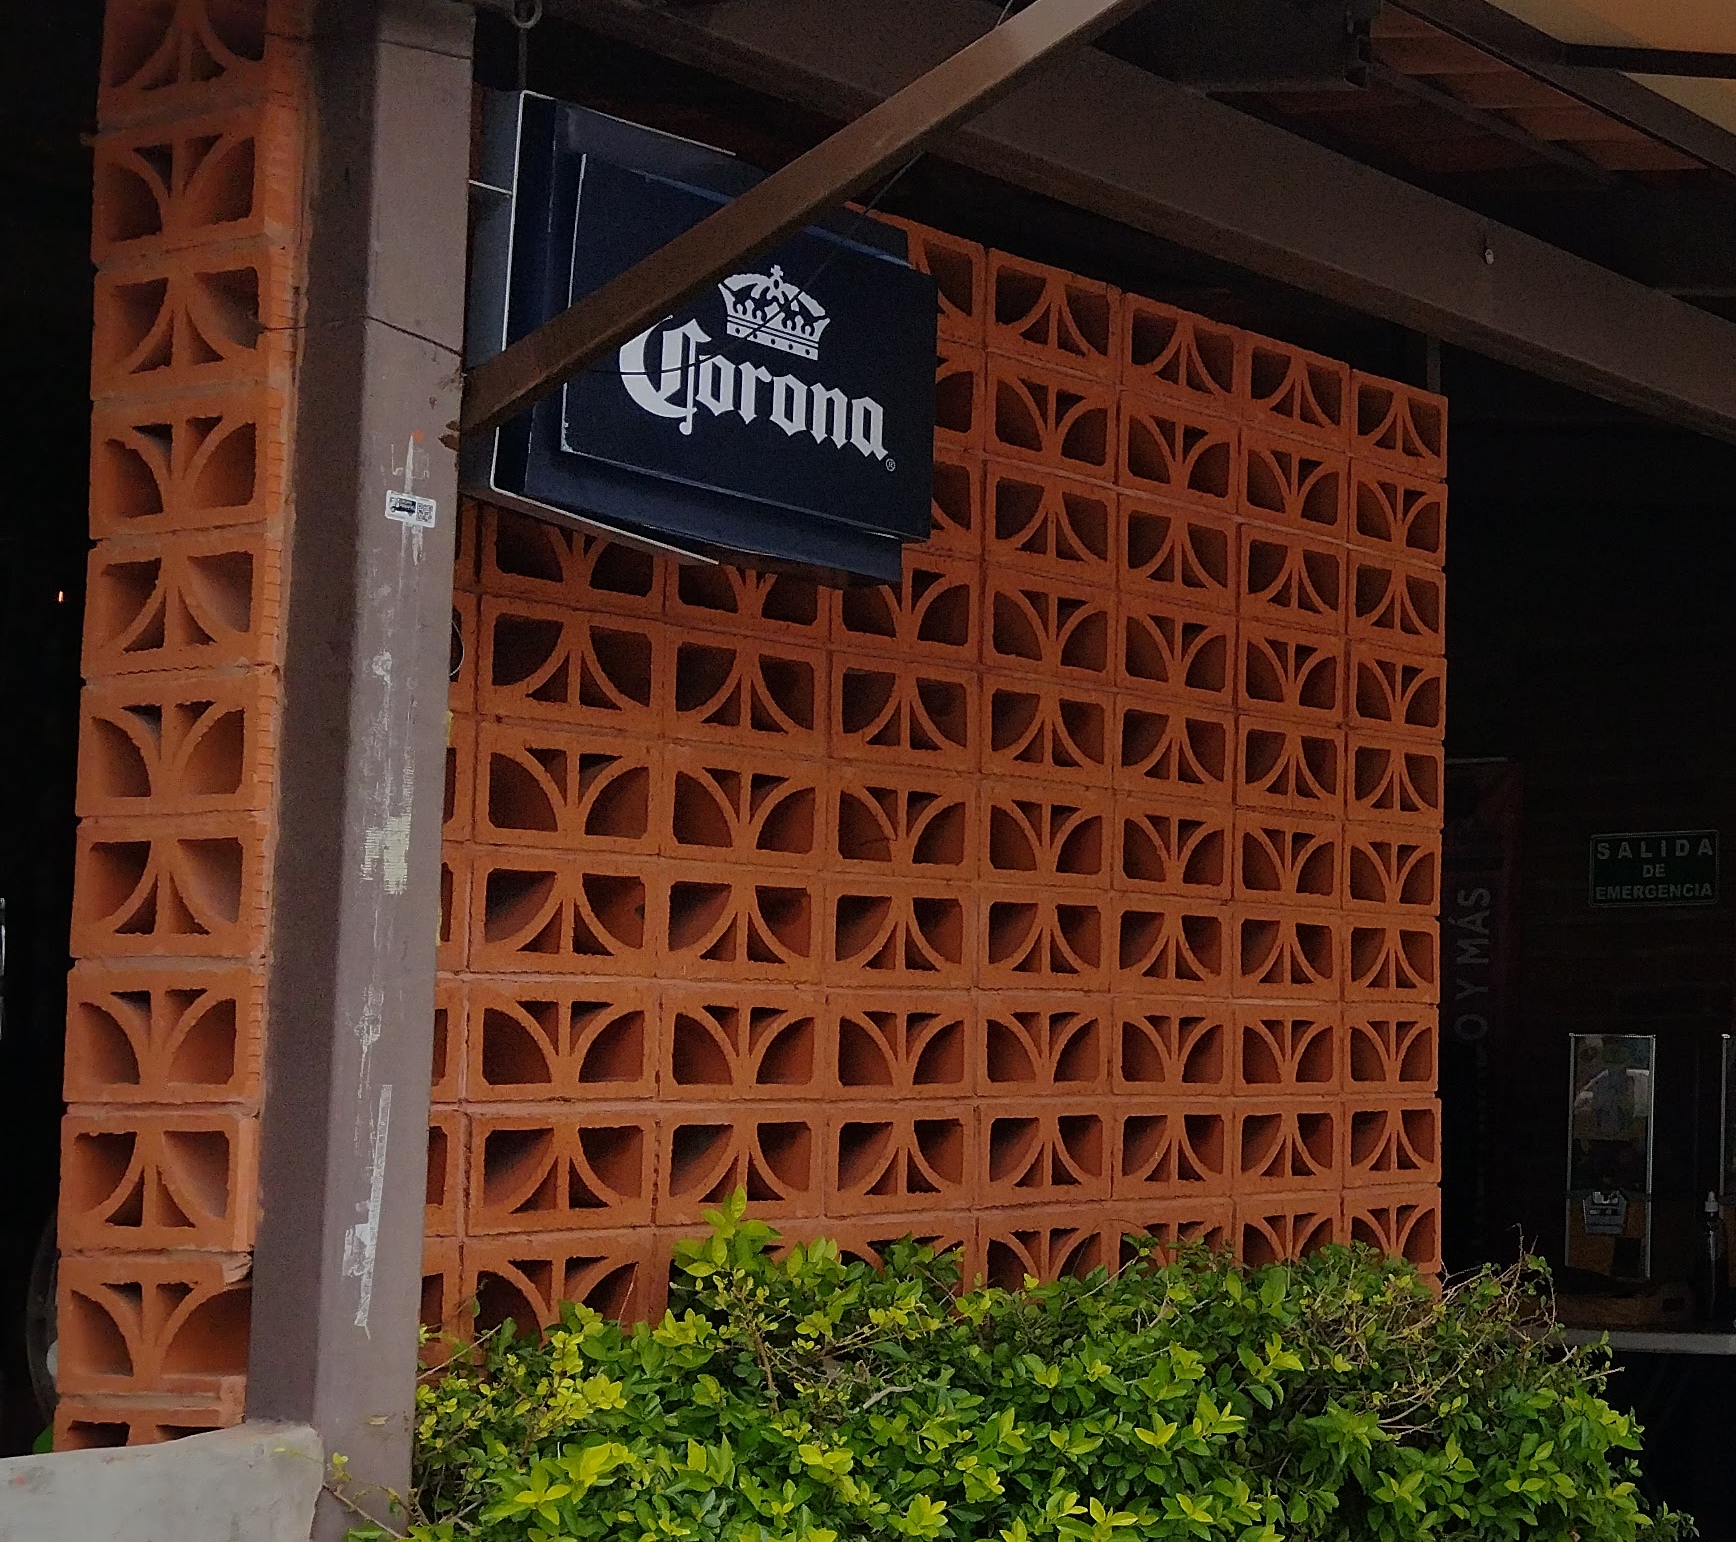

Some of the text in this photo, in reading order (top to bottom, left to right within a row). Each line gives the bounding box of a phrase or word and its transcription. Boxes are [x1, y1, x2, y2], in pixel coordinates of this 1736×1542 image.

[619, 314, 888, 461] Corona
[1596, 838, 1713, 860] SALIDA
[1642, 863, 1666, 878] DE
[1595, 883, 1713, 900] EMERGENCIA
[1447, 888, 1491, 964] MÁS
[1455, 978, 1489, 1002] Y
